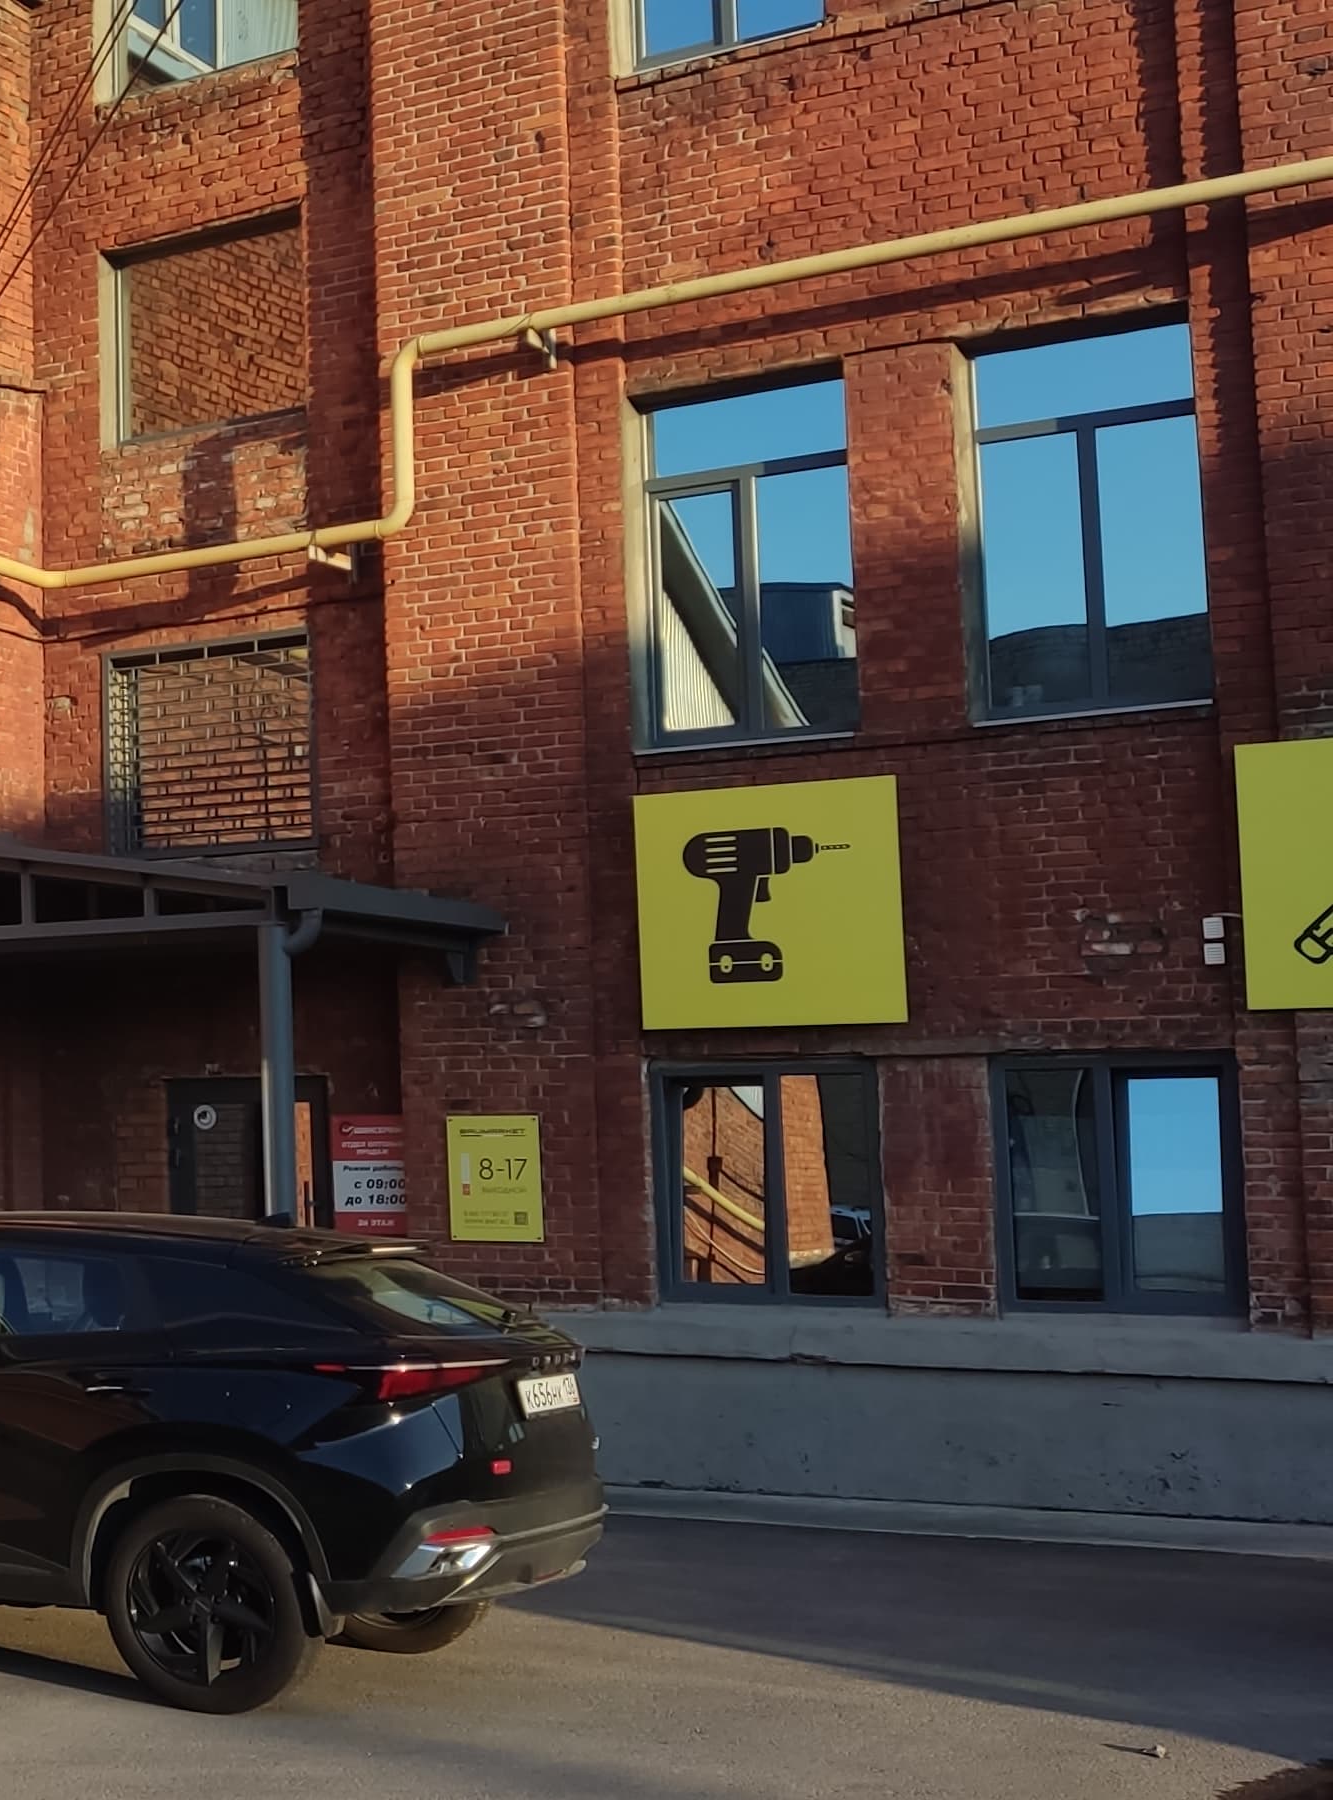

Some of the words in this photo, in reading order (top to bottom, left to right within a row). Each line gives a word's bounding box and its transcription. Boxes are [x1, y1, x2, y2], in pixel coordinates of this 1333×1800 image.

[479, 1158, 527, 1181] 8-17
[354, 1181, 362, 1189] с
[367, 1179, 406, 1189] 09:00
[345, 1196, 362, 1206] до
[369, 1194, 406, 1204] 18:00
